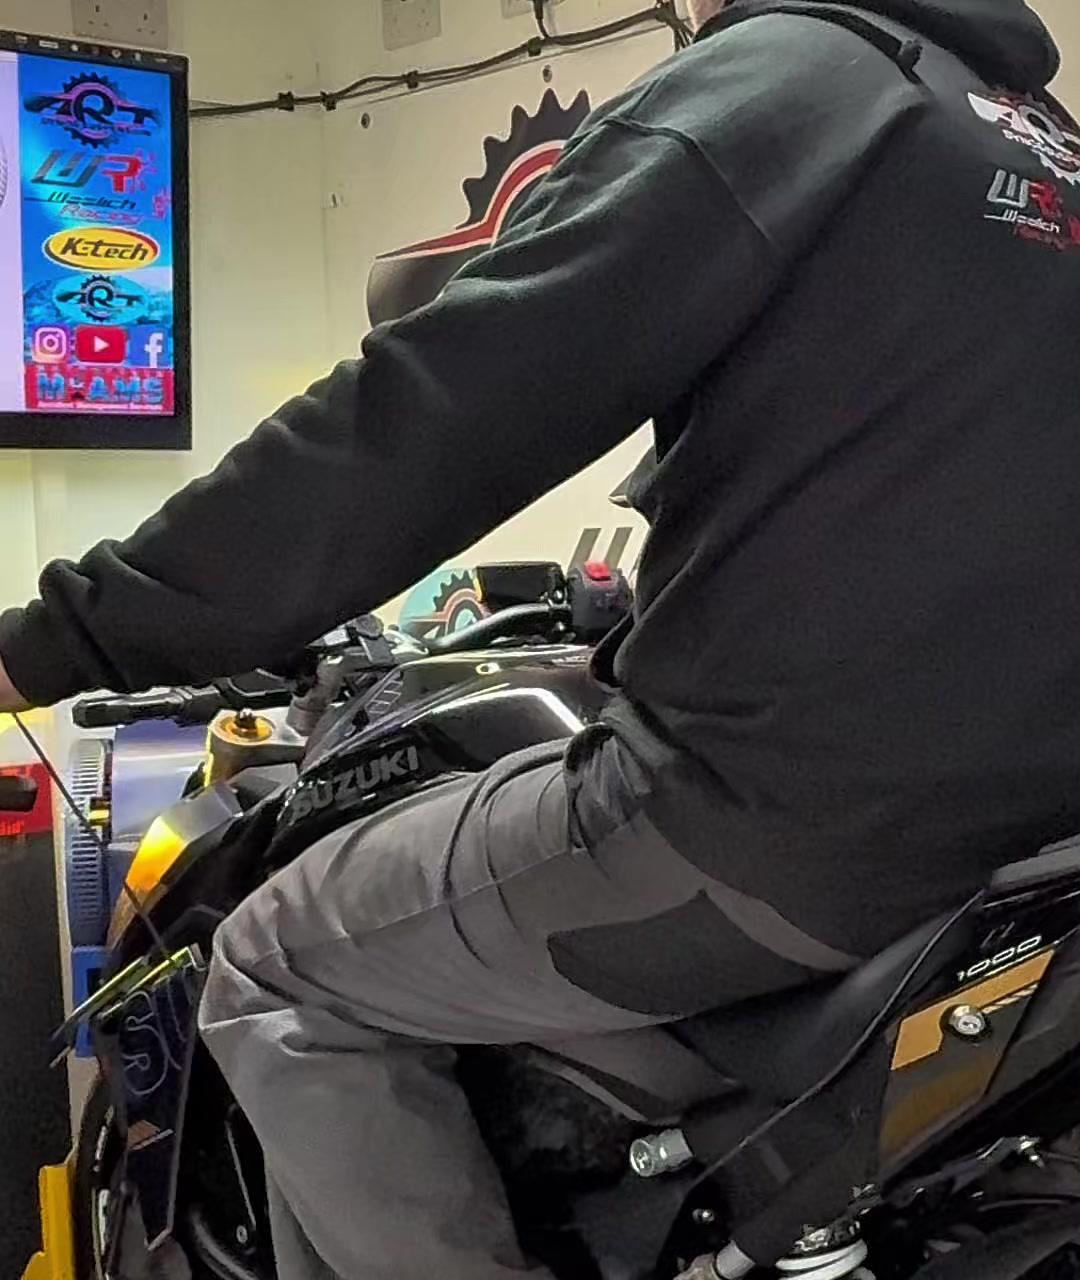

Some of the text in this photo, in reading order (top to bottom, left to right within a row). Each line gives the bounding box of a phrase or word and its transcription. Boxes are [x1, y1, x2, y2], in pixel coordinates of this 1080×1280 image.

[60, 236, 149, 261] K-tech
[290, 745, 421, 823] SUZUKI
[957, 935, 1042, 982] 1000
